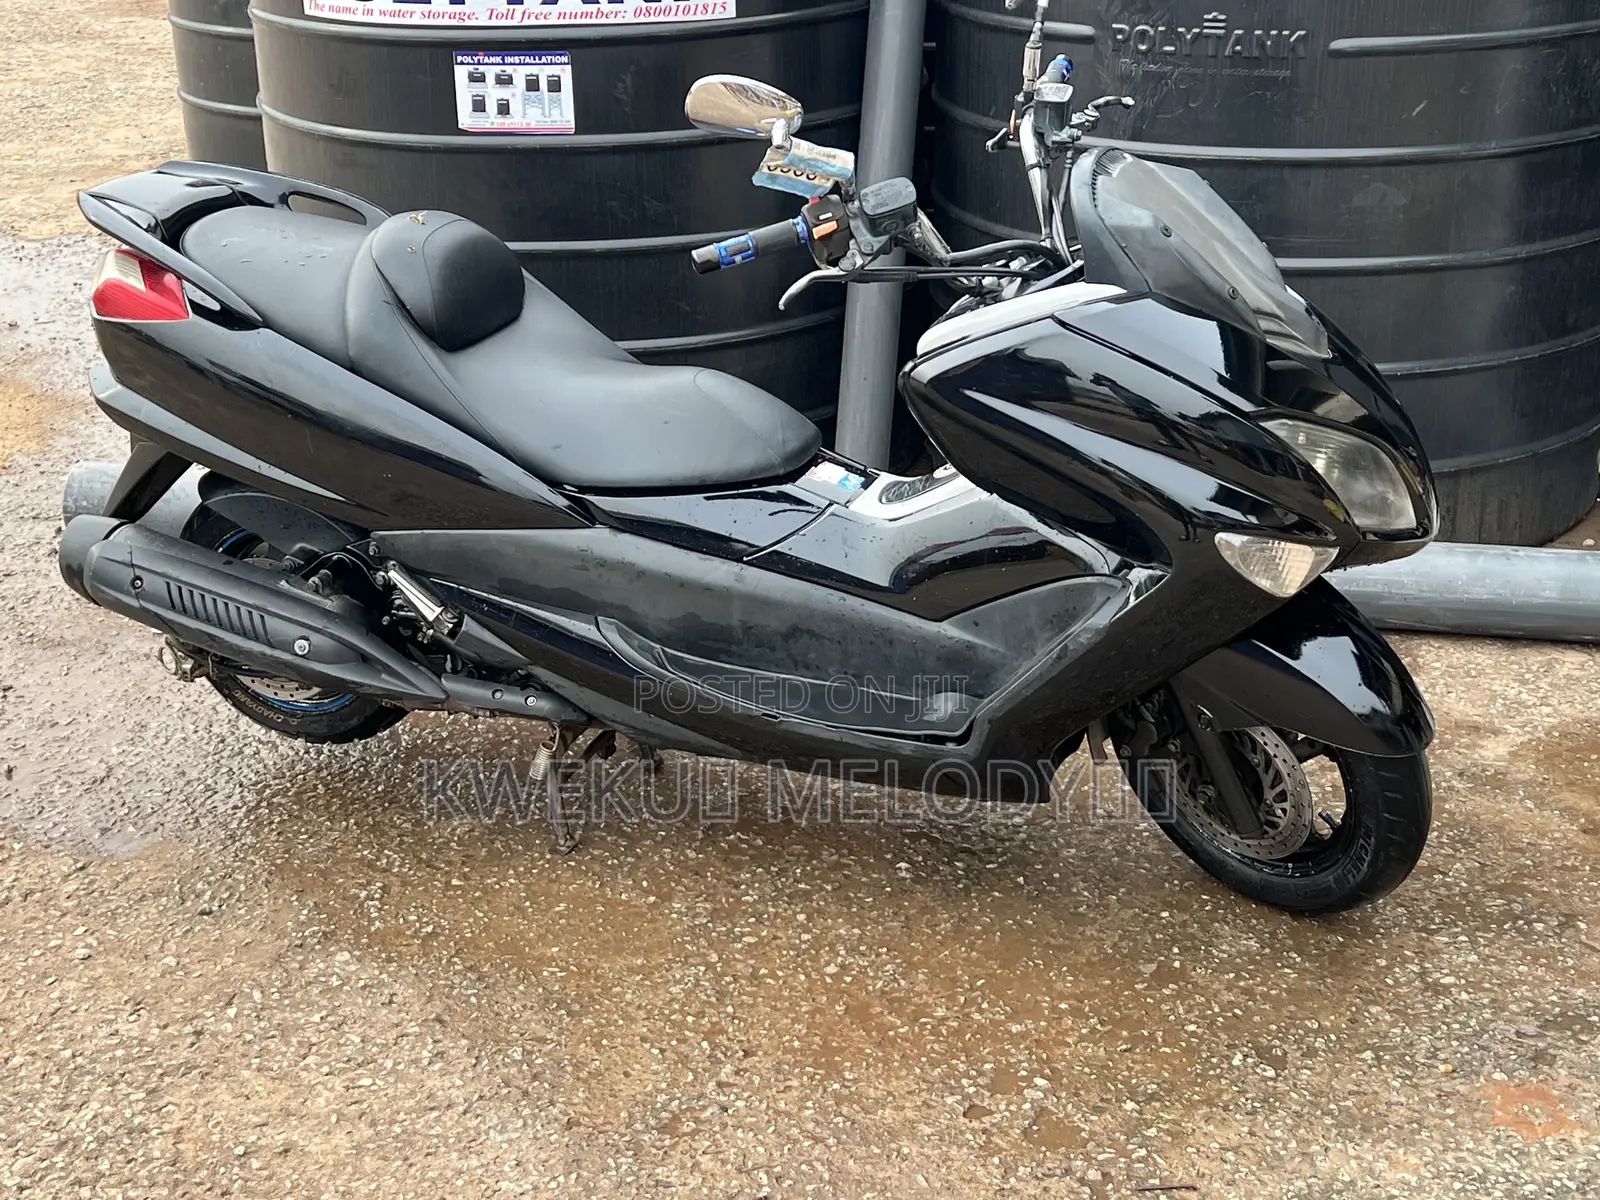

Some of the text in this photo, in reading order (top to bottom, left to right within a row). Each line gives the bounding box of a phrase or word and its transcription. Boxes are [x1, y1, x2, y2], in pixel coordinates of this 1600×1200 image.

[309, 0, 325, 11] The
[328, 5, 358, 16] name
[362, 4, 374, 17] in
[378, 9, 416, 19] water
[419, 8, 479, 21] storage.
[486, 7, 515, 21] Toll
[517, 8, 552, 24] free
[557, 8, 628, 20] number:
[633, 1, 727, 19] 0800101815
[1111, 12, 1307, 59] POLYTANK
[457, 56, 568, 64] POLYTANK INSTALLATION
[232, 689, 285, 723] CHAOYANG
